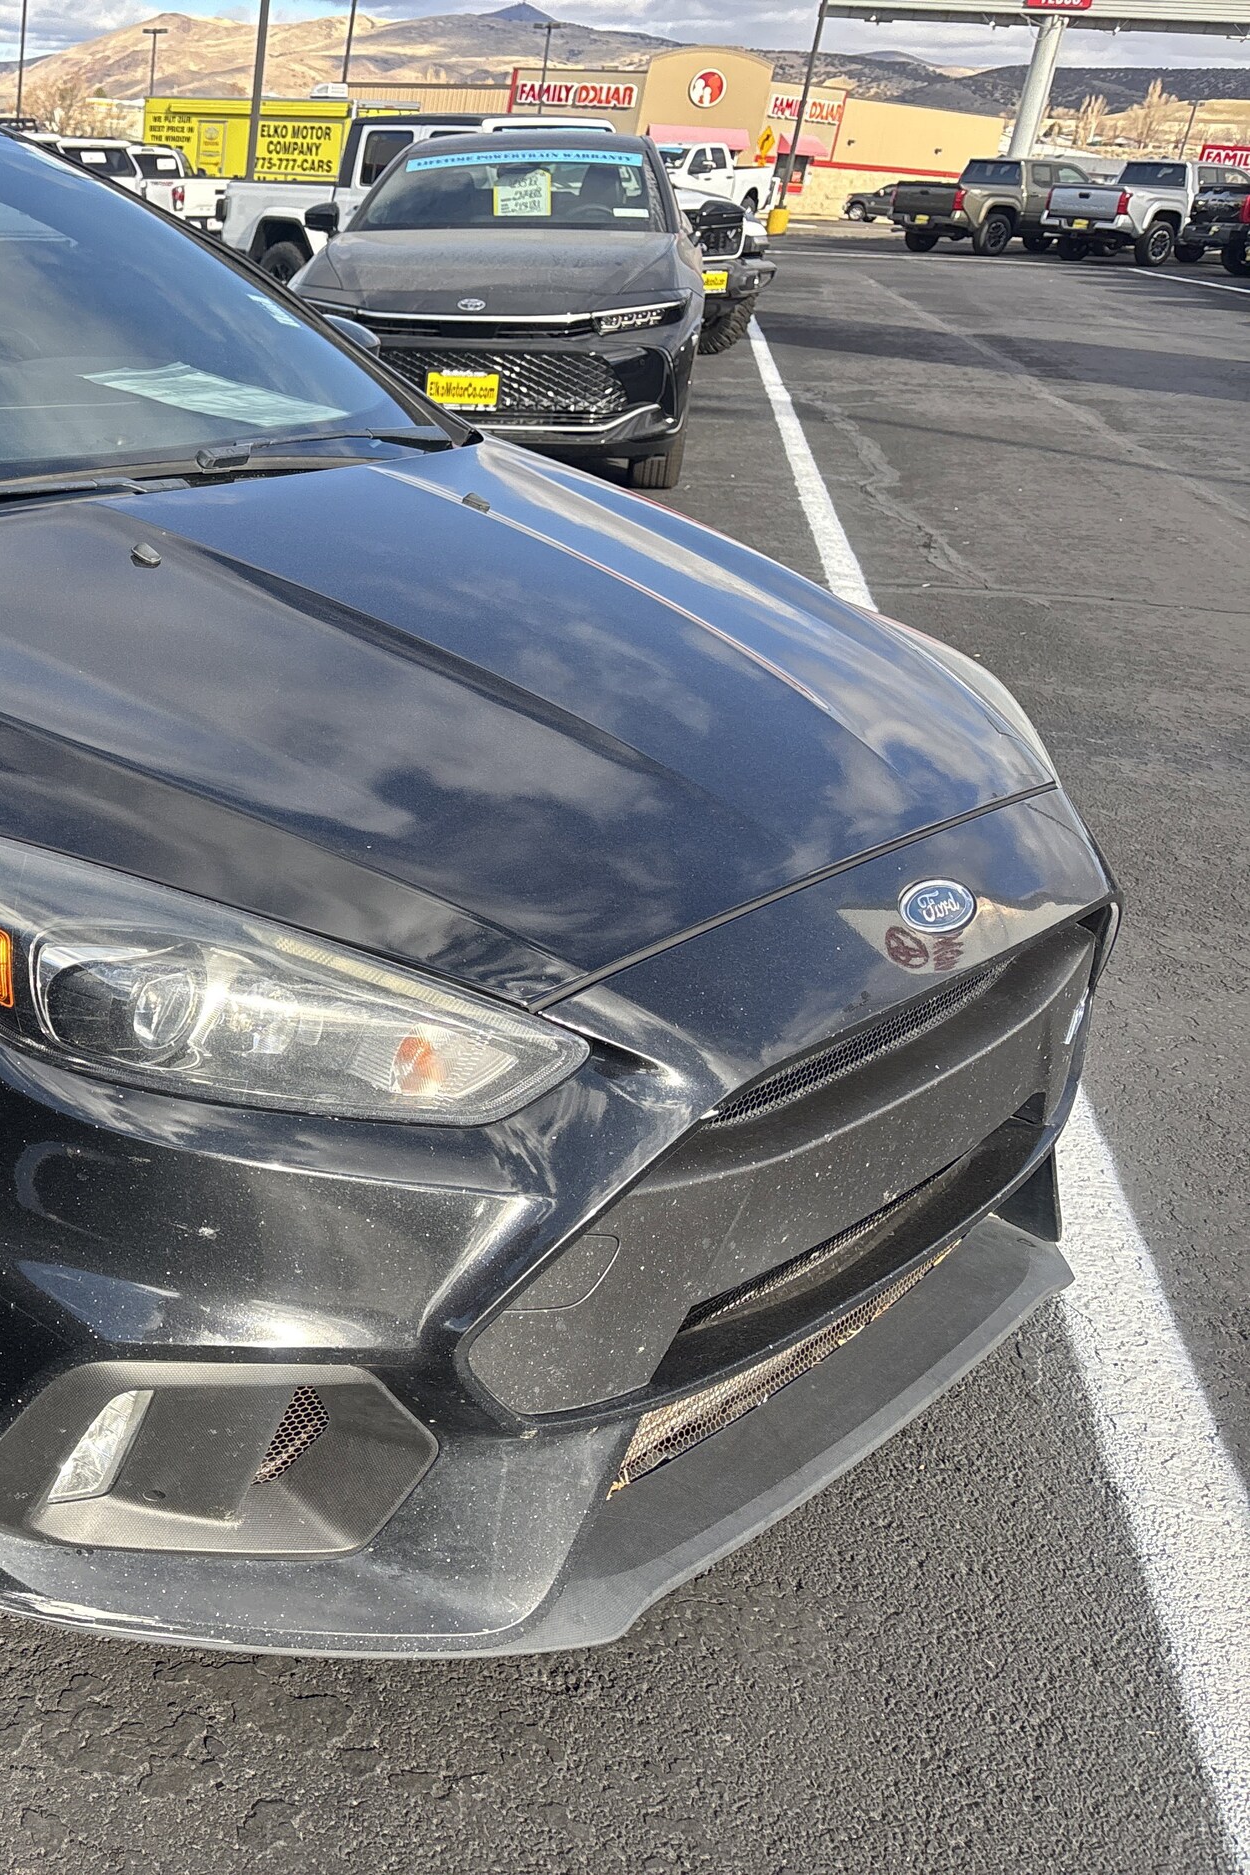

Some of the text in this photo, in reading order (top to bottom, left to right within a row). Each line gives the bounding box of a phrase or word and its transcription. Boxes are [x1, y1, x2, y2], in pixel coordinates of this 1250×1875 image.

[520, 83, 634, 105] FAMILY DOLLAR
[260, 124, 332, 140] ELKO MOTOR
[267, 141, 322, 156] COMPANY
[254, 157, 333, 173] 775-777-CARS
[563, 153, 633, 162] WARRANTY
[429, 381, 495, 399] ElkoMotorCo.com
[917, 890, 960, 923] Ford
